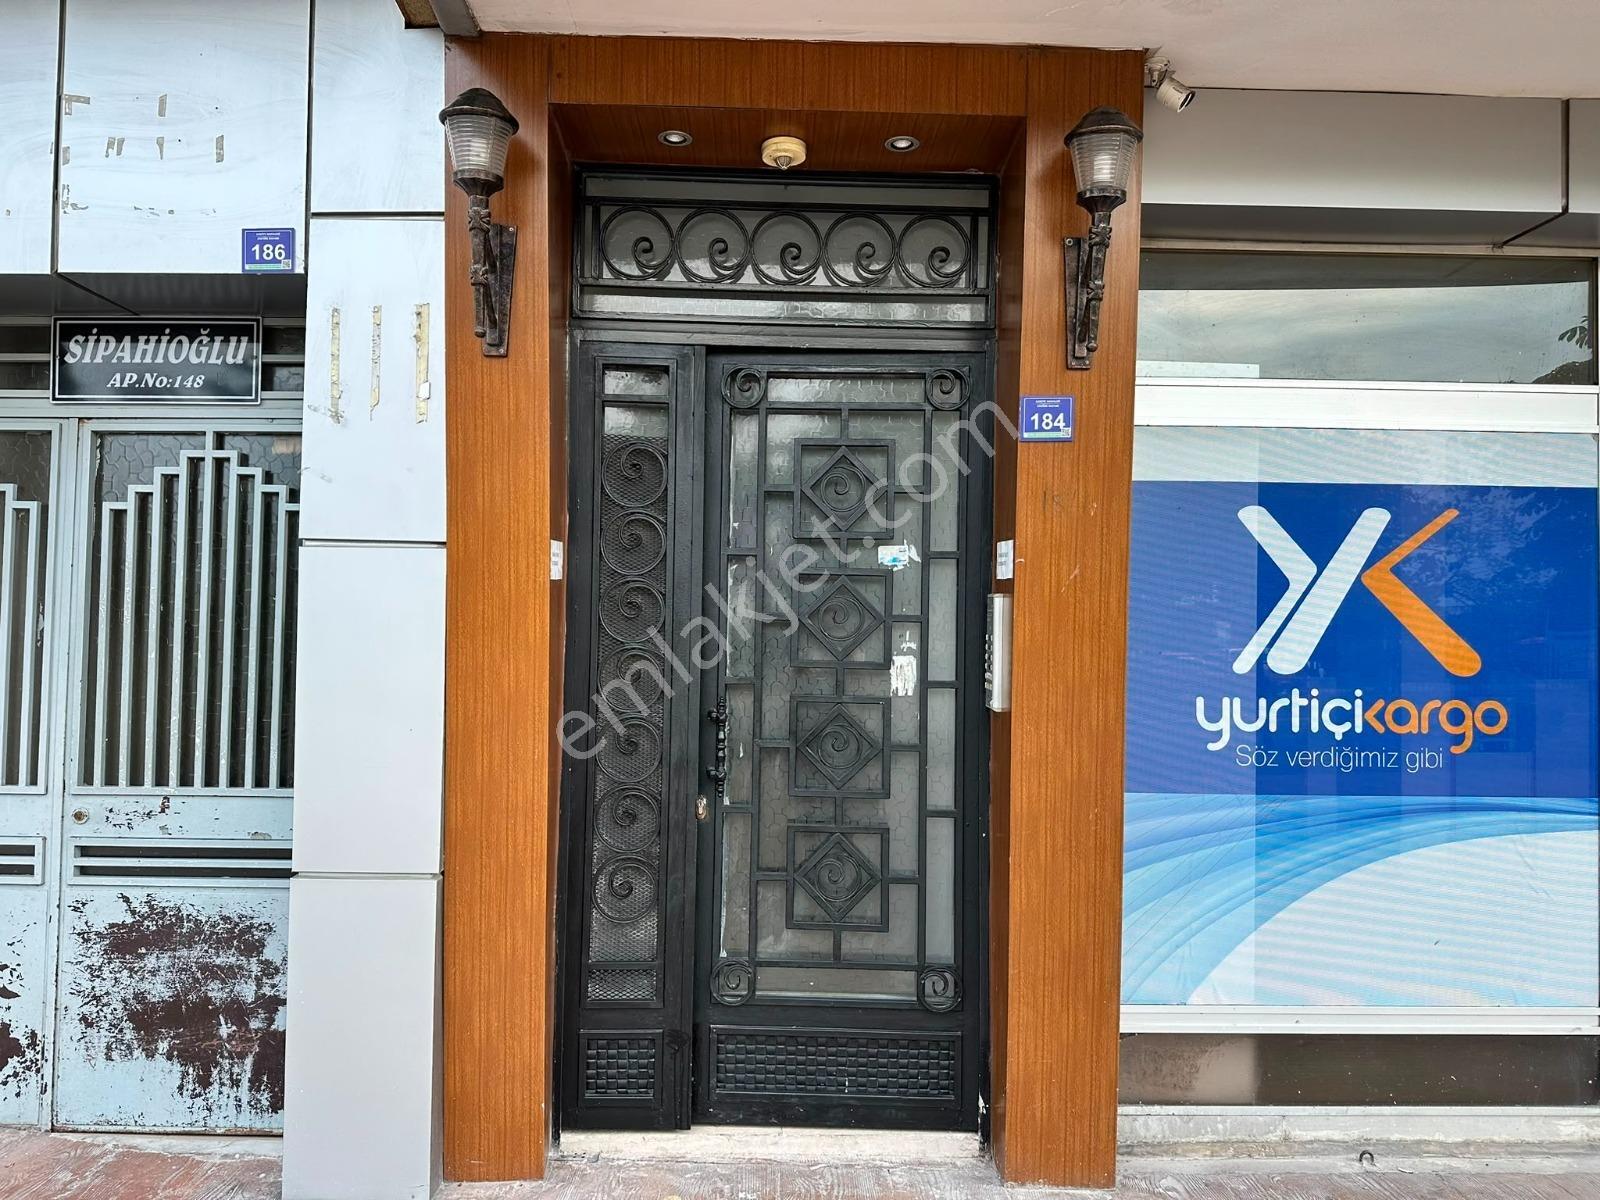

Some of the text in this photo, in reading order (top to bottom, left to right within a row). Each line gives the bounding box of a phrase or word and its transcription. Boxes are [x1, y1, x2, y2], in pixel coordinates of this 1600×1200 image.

[251, 243, 286, 261] 186
[63, 327, 249, 365] SİPAHİOĞLU
[1030, 412, 1066, 430] 184
[1235, 744, 1444, 773] Söz verdiğimiz gibi
